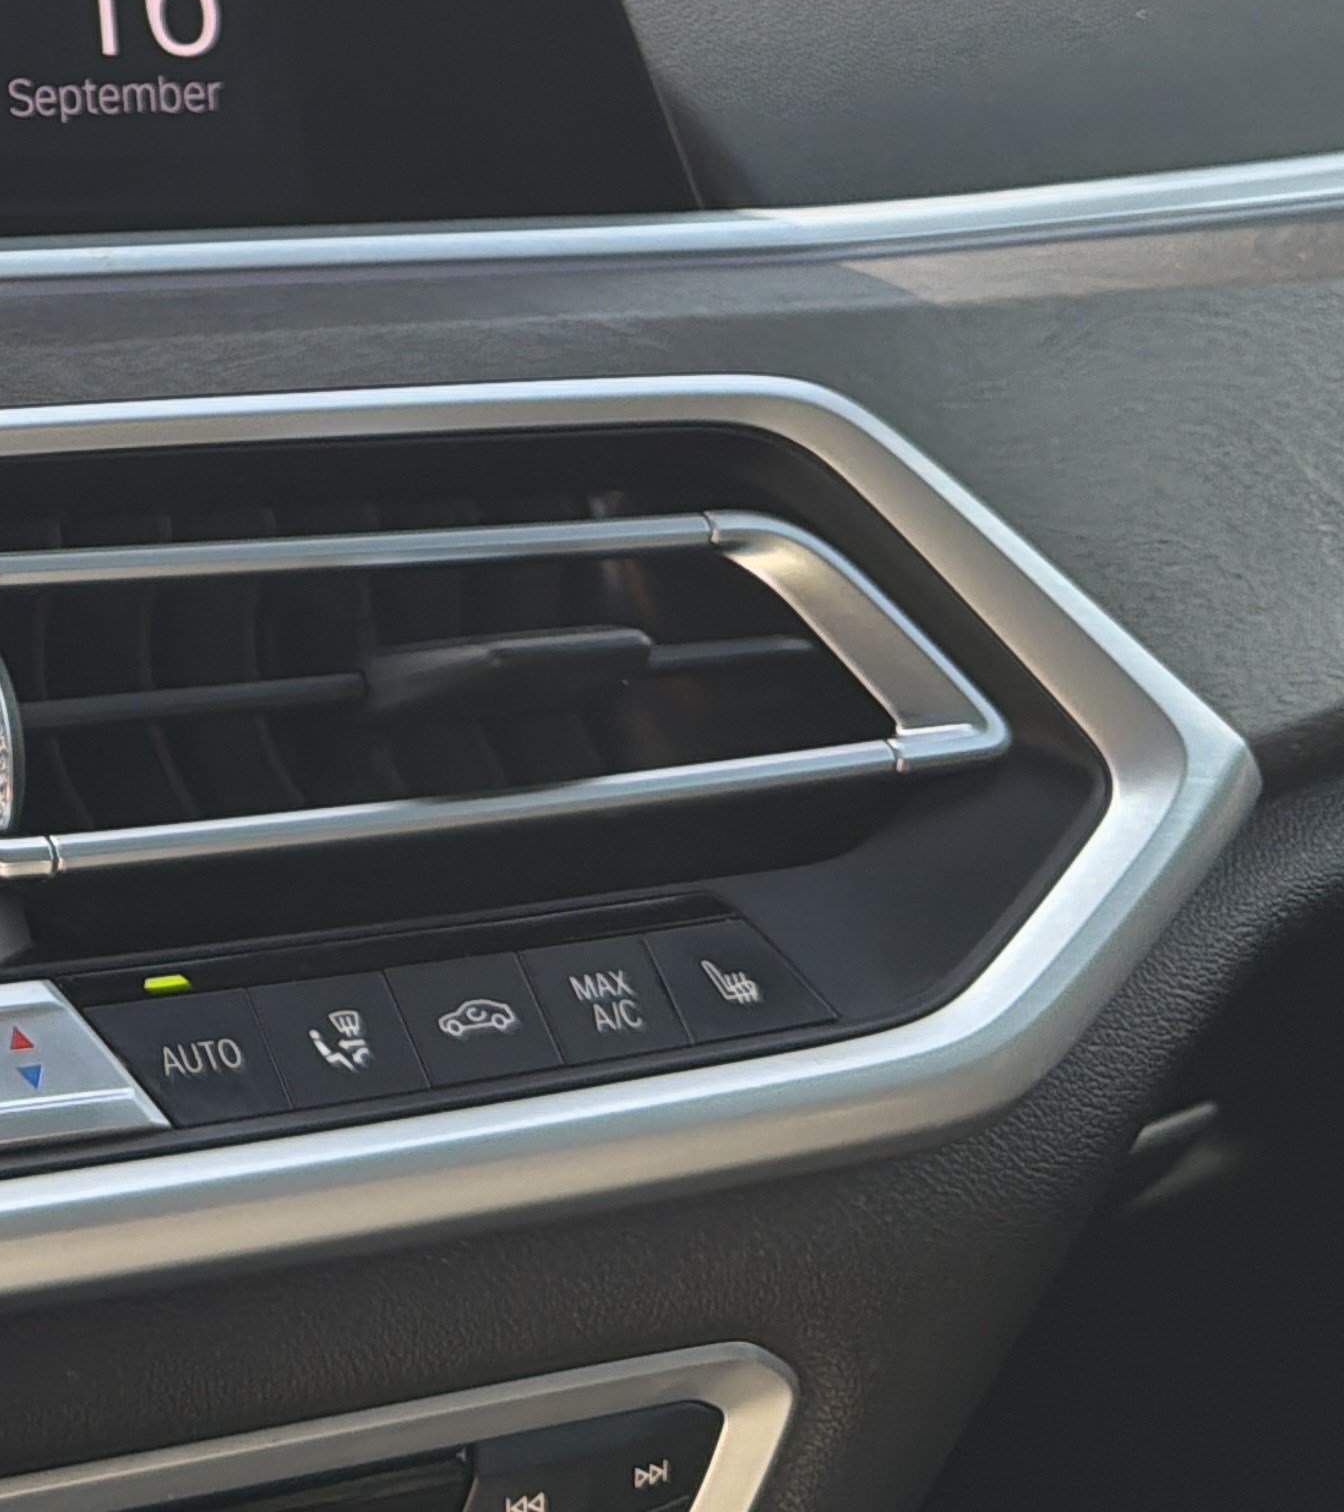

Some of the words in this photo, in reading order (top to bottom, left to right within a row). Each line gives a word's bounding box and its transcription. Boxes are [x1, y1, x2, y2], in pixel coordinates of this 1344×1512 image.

[8, 75, 223, 123] September
[569, 971, 634, 1002] MAX
[593, 1001, 643, 1033] A/C
[162, 1036, 244, 1078] AUTO
